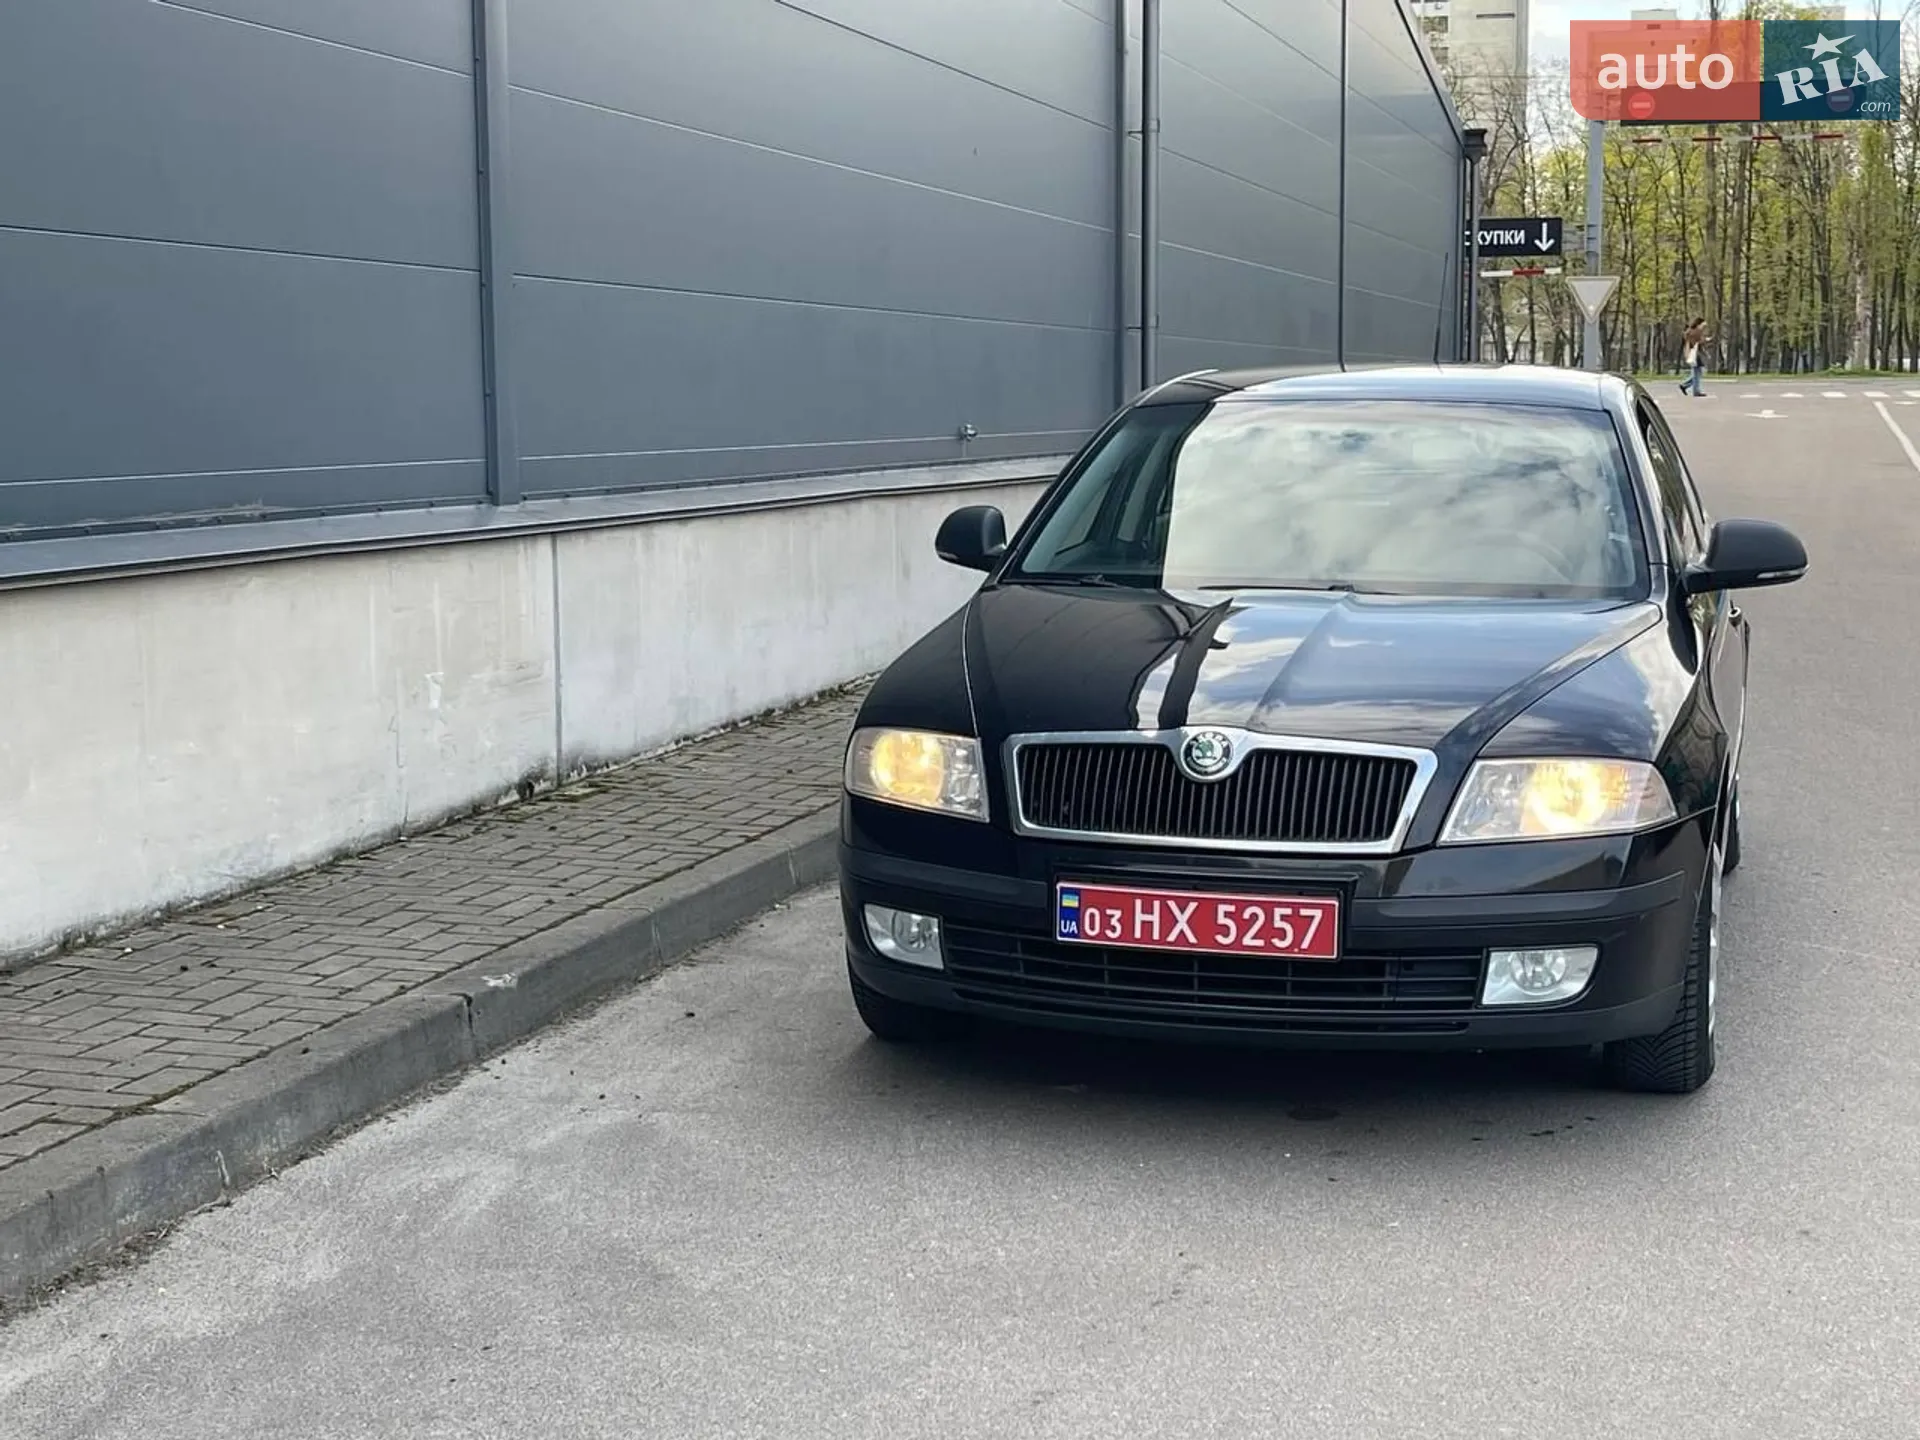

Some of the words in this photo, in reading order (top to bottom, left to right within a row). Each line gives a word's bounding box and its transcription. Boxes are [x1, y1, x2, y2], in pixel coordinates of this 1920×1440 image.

[1060, 919, 1078, 934] UA
[1083, 907, 1122, 939] 03
[1133, 898, 1199, 944] HX
[1213, 904, 1323, 950] 5257
